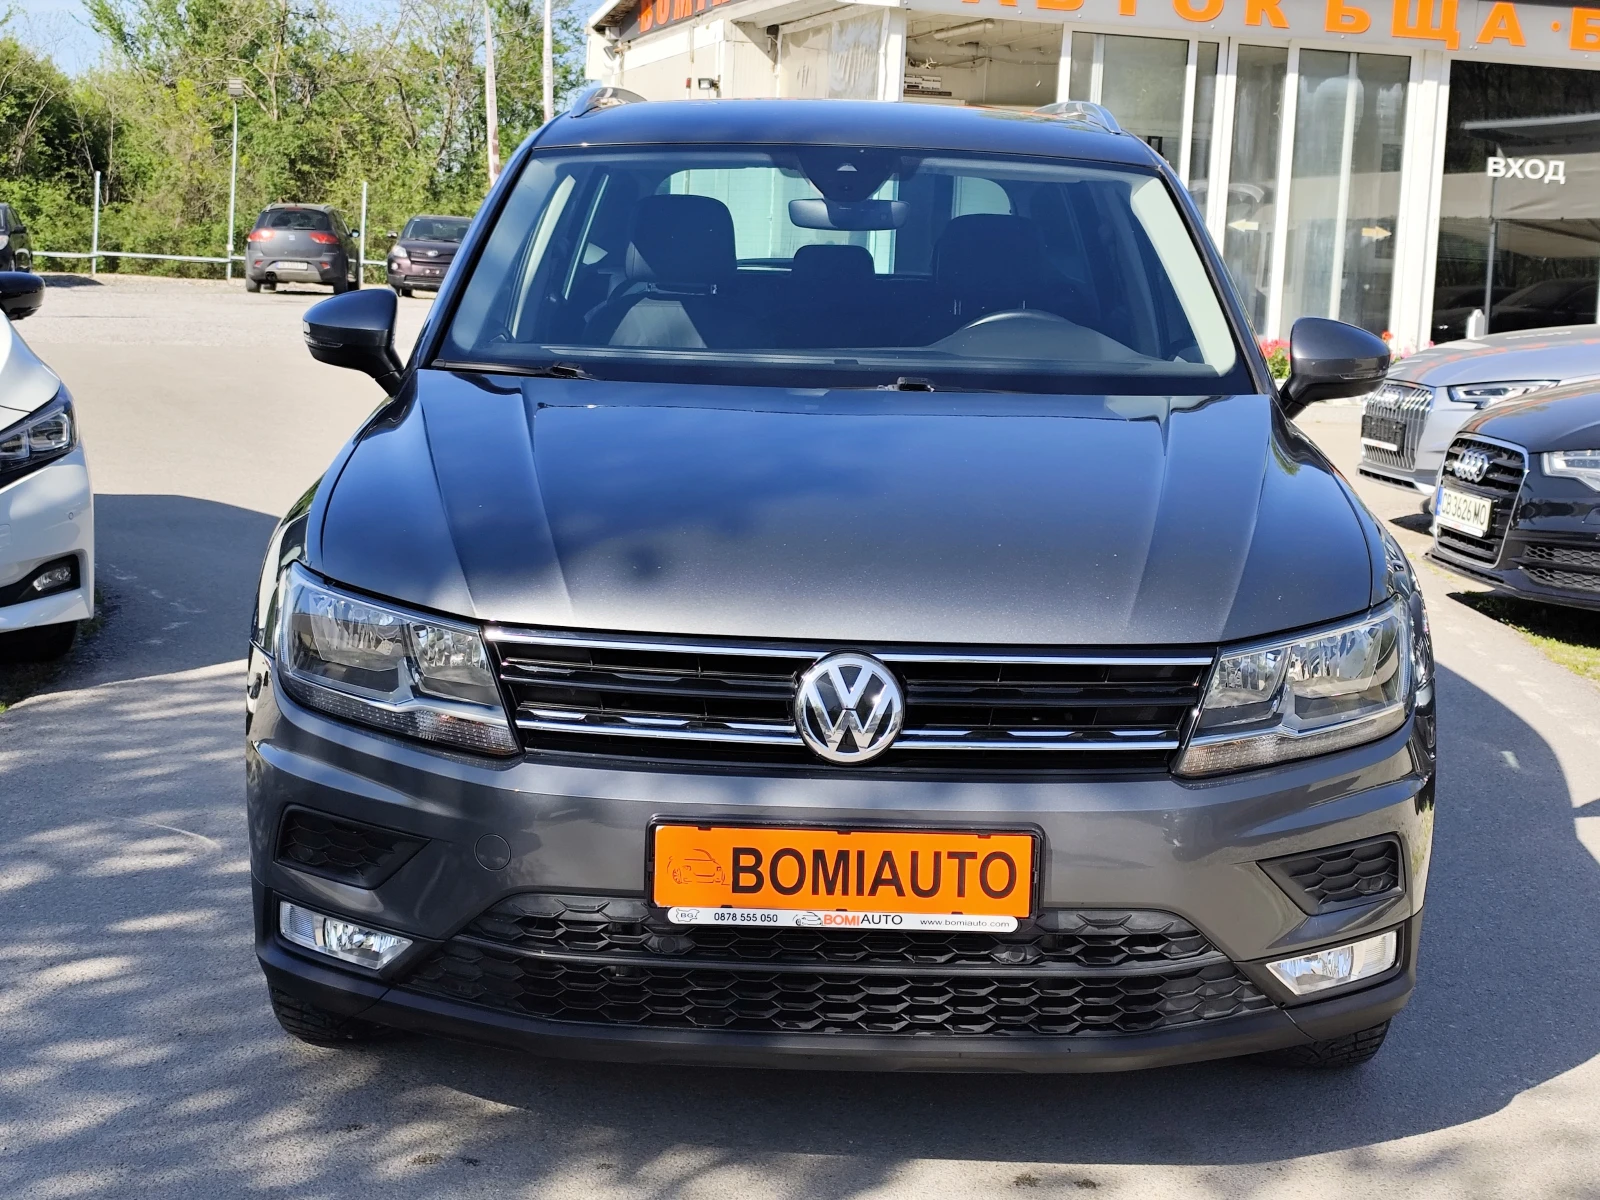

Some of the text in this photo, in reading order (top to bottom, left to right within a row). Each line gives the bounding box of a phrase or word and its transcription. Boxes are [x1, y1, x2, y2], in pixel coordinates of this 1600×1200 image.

[1487, 156, 1566, 185] ВХОД
[1452, 496, 1472, 521] 3626
[795, 652, 905, 763] VW
[731, 847, 1016, 899] BOMIAUTO
[713, 912, 778, 923] 0878 555 050
[919, 918, 1011, 928] www.bomiauto.com
